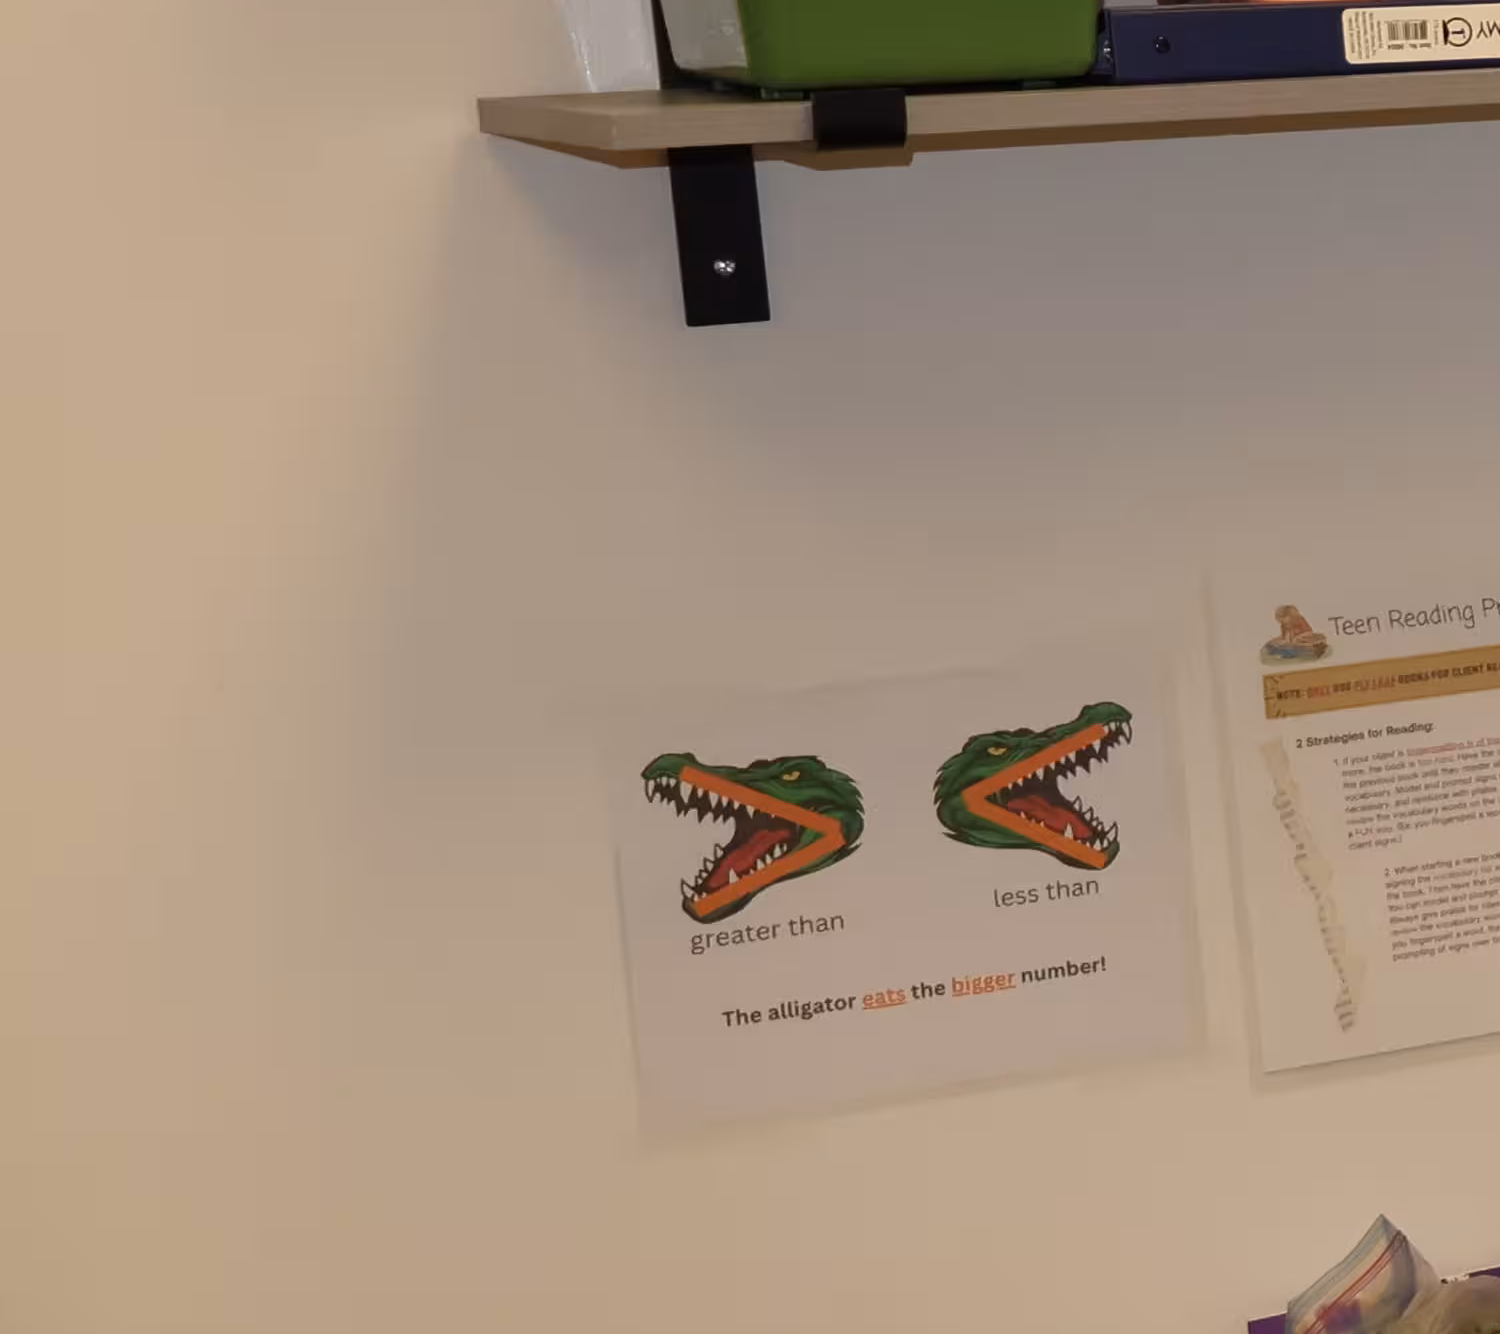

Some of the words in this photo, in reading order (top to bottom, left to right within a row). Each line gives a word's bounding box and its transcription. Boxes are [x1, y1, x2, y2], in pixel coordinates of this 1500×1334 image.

[1327, 615, 1381, 636] Teen
[1388, 603, 1476, 630] Reading
[1306, 732, 1365, 749] Strategies
[1367, 729, 1383, 739] for
[1385, 722, 1433, 737] Reading:
[993, 885, 1041, 908] less
[1045, 878, 1100, 901] than
[690, 922, 781, 956] greater
[787, 913, 846, 939] than
[722, 1006, 763, 1029] The
[767, 993, 857, 1022] alligator
[861, 986, 908, 1010] eats
[911, 980, 947, 1002] the
[951, 969, 1017, 997] bigger
[1021, 955, 1108, 985] number!
